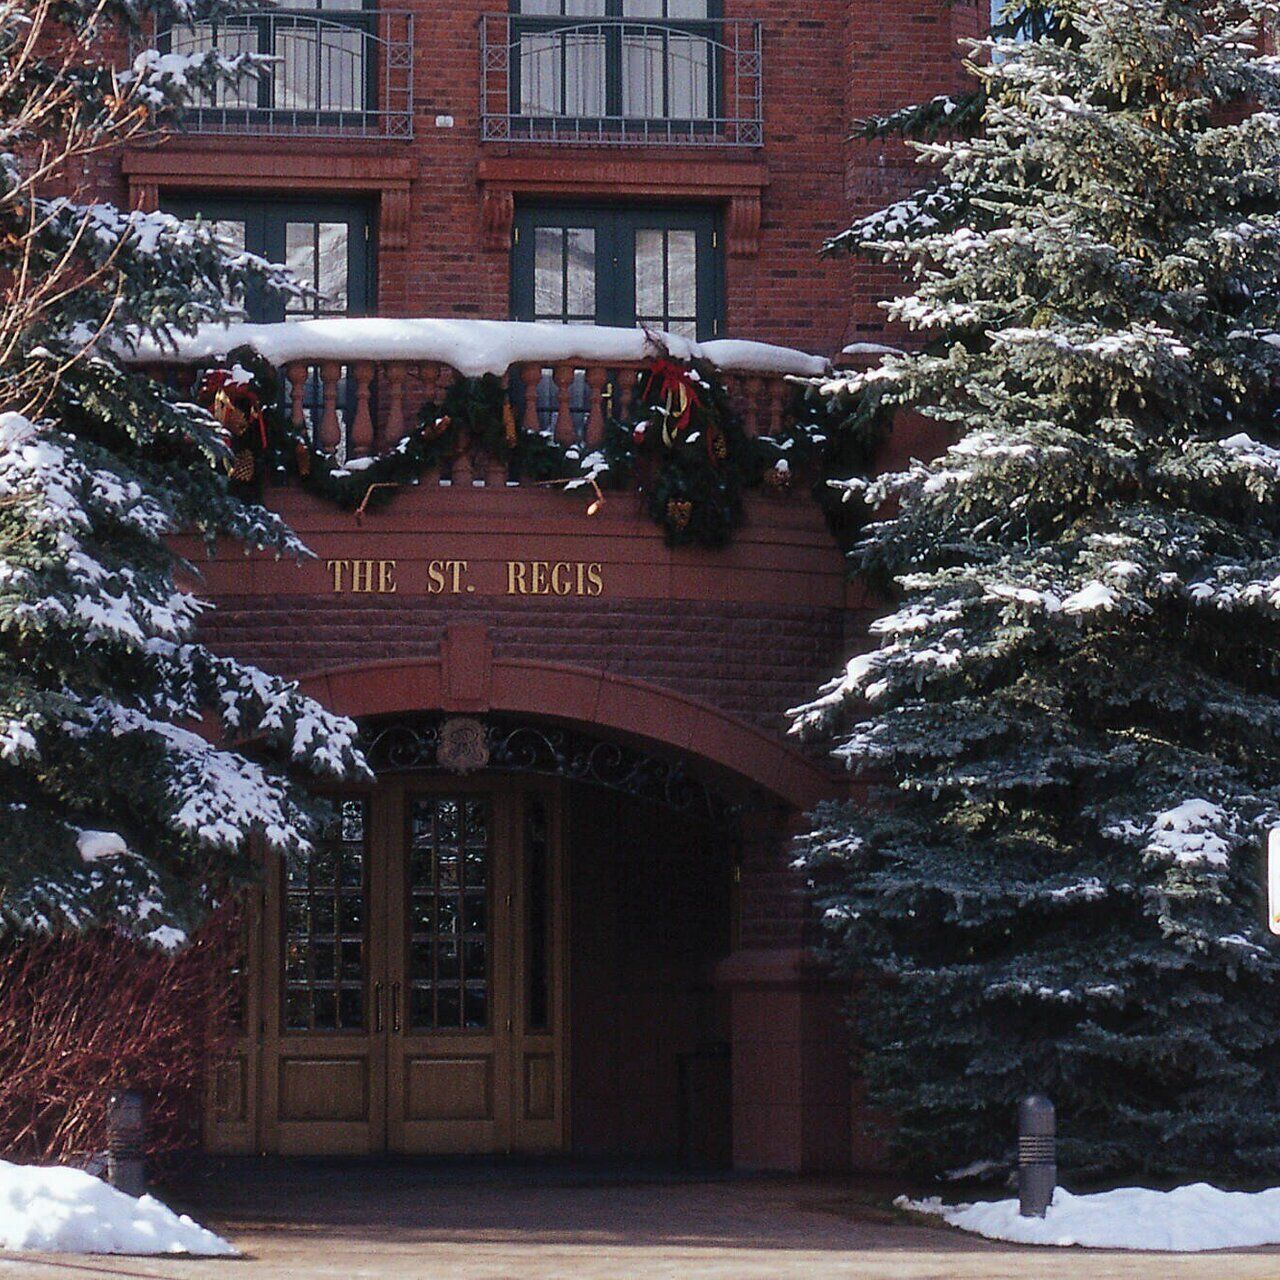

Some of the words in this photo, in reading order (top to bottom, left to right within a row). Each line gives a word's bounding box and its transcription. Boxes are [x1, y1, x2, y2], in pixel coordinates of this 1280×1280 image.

[327, 560, 396, 593] THE
[427, 560, 475, 594] ST.
[507, 561, 603, 596] REGIS
